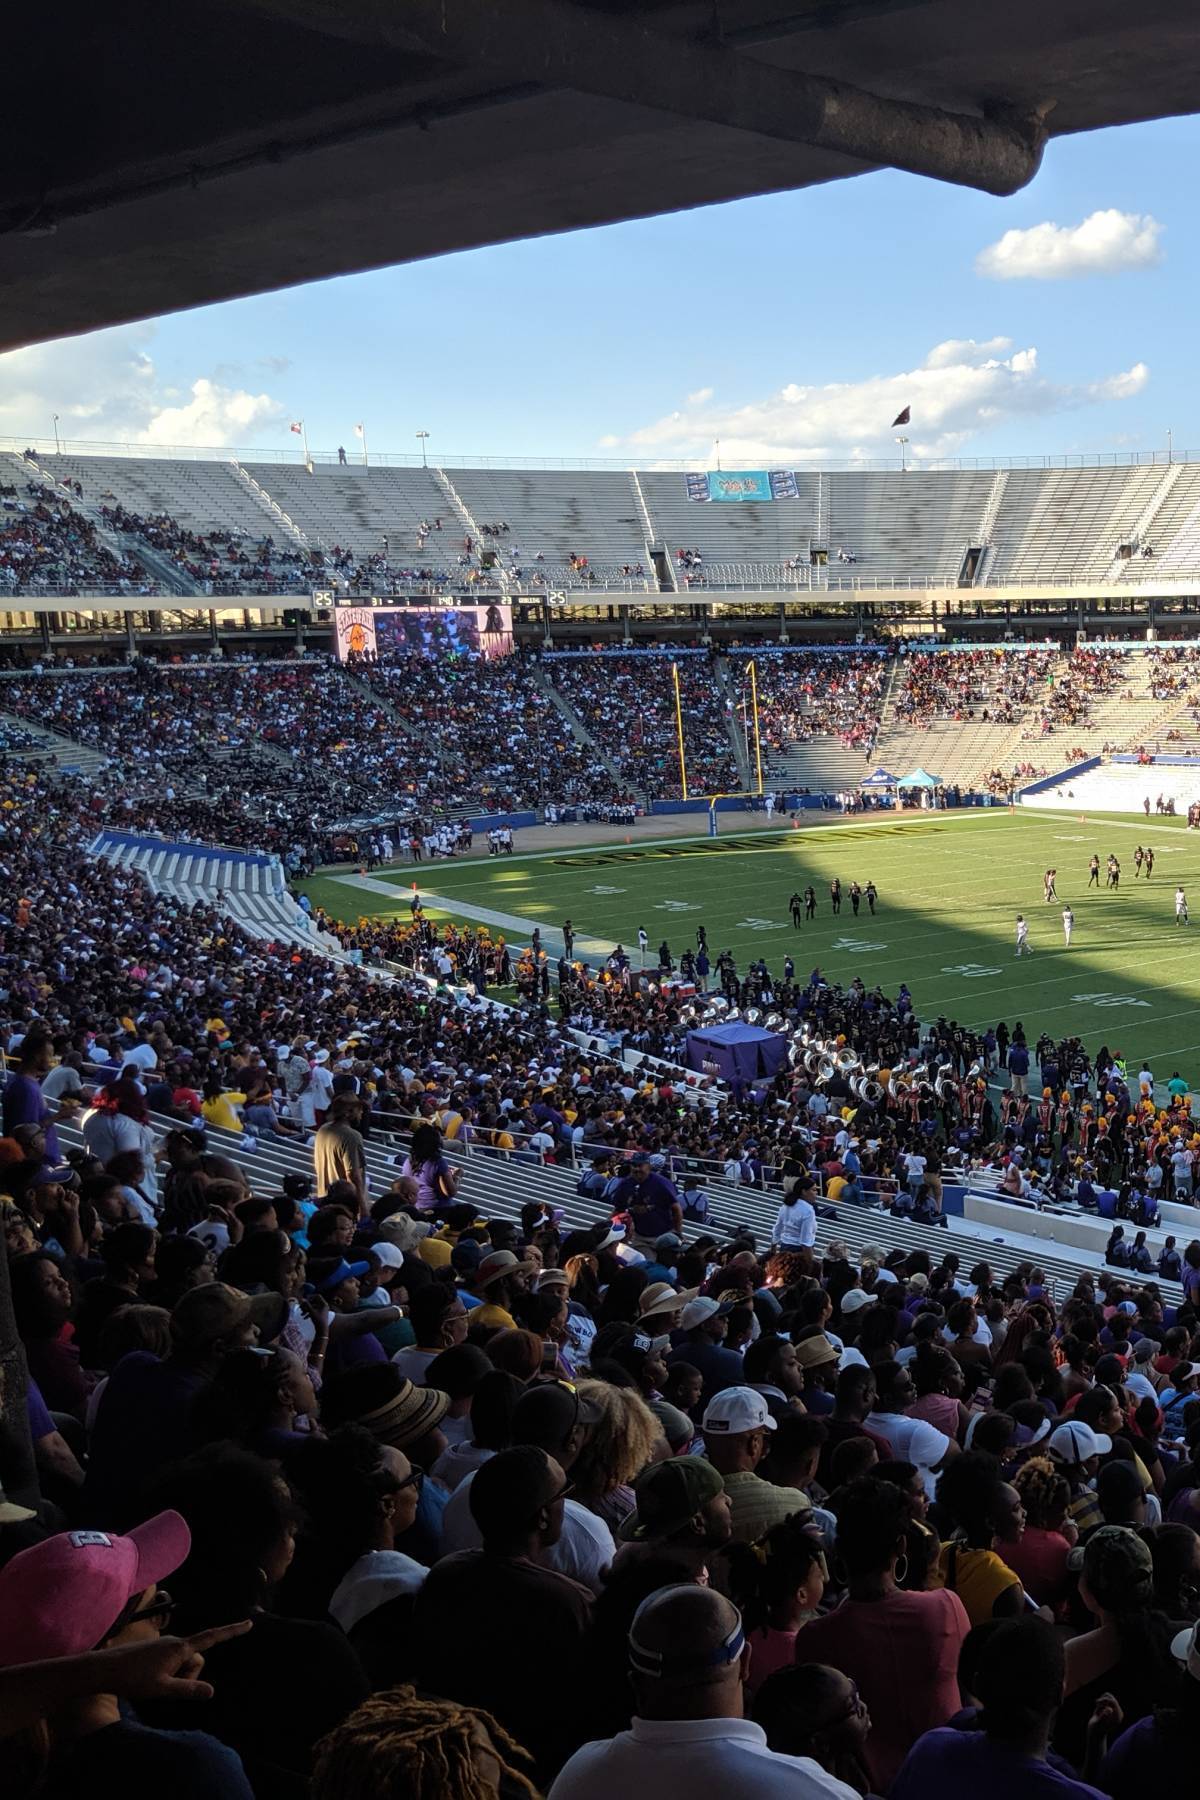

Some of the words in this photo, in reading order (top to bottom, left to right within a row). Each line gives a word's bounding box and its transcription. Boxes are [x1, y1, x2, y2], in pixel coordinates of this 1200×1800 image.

[315, 593, 332, 606] 25
[549, 592, 565, 604] 25
[553, 827, 947, 867] GRAMBLING
